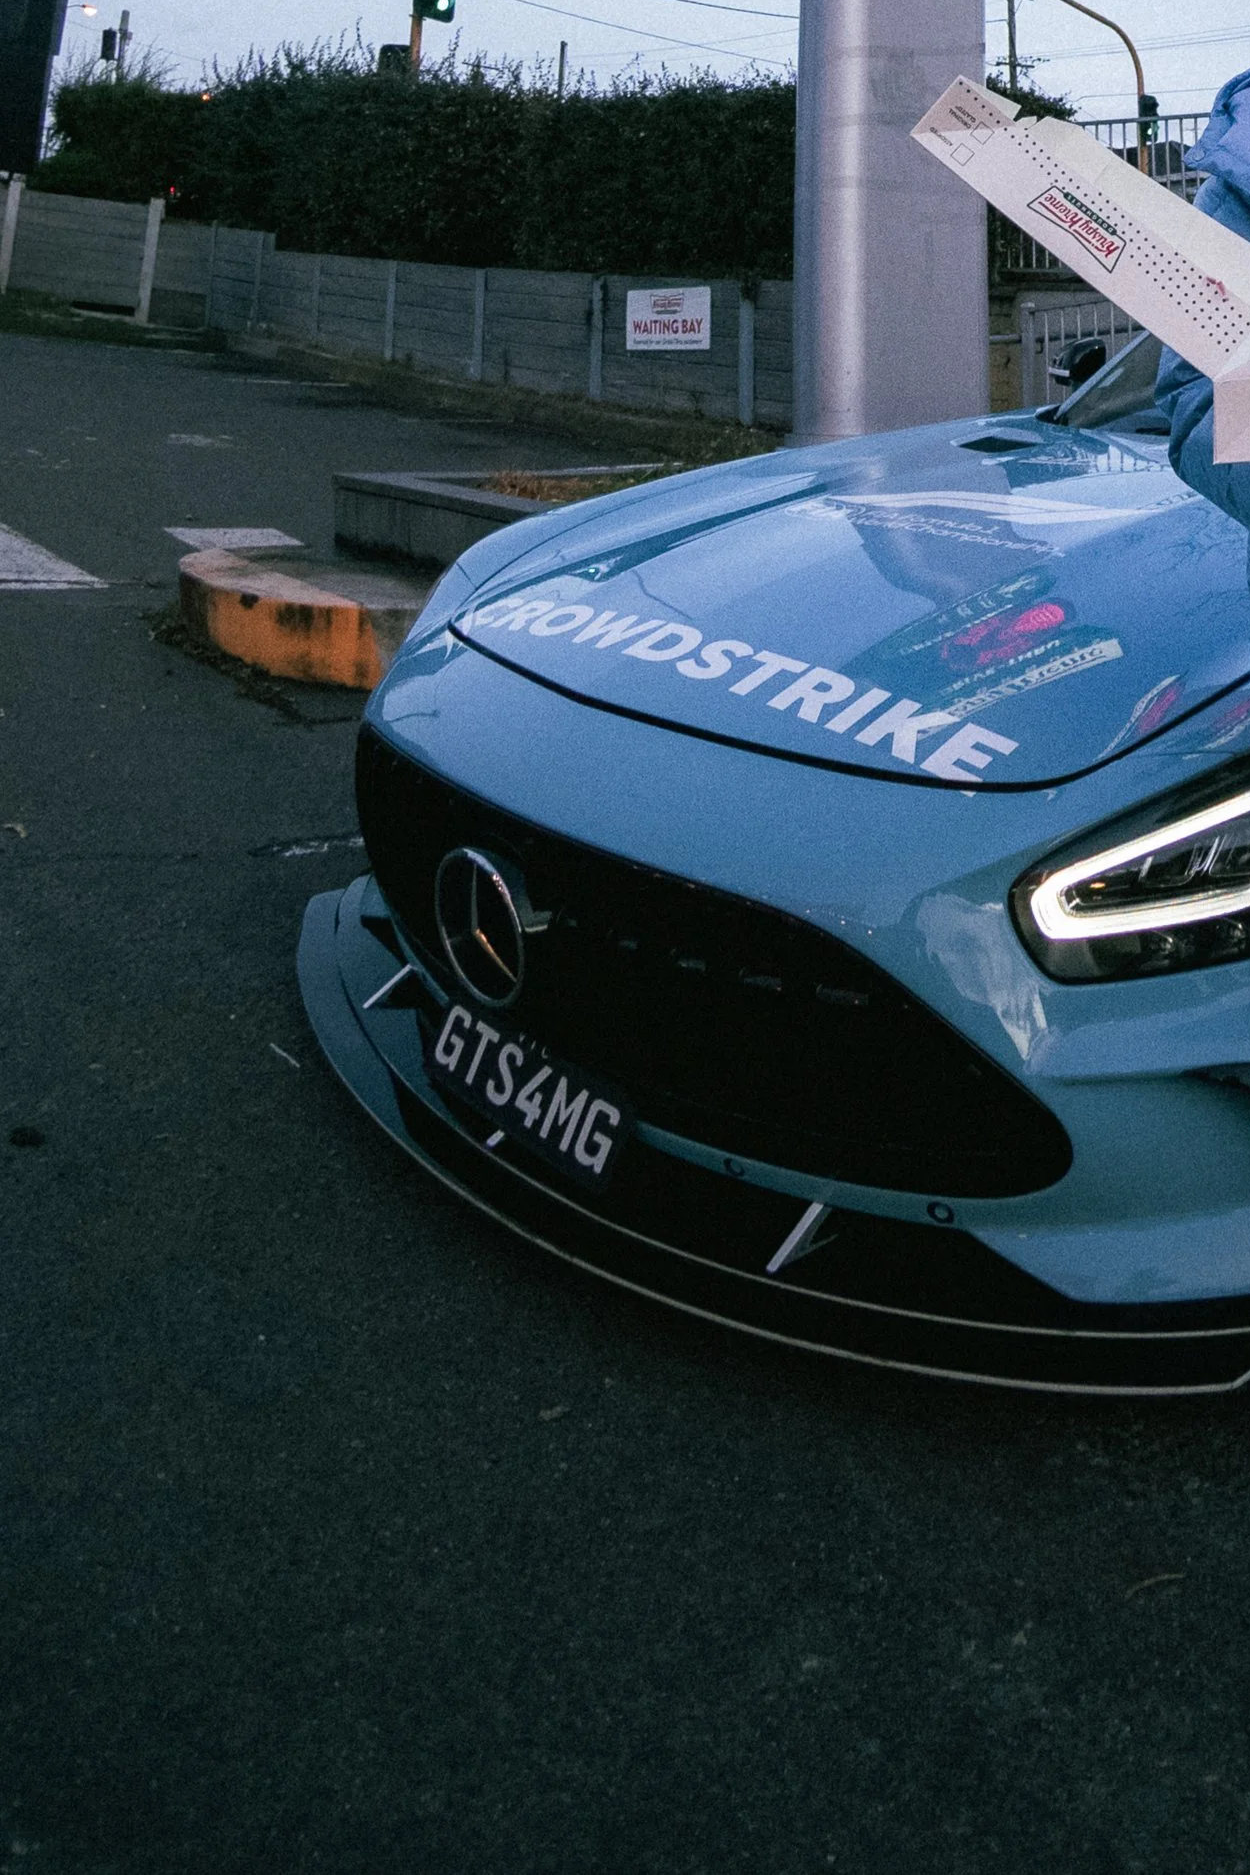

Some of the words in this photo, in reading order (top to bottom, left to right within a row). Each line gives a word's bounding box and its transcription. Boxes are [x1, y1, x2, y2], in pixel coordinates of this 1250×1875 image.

[1038, 193, 1083, 230] Kreme
[1073, 219, 1120, 258] Krispy
[633, 319, 679, 334] WAITING
[682, 318, 703, 334] BAY
[474, 597, 1019, 796] CROWDSTRIKE
[434, 1005, 621, 1174] GTS4MG
